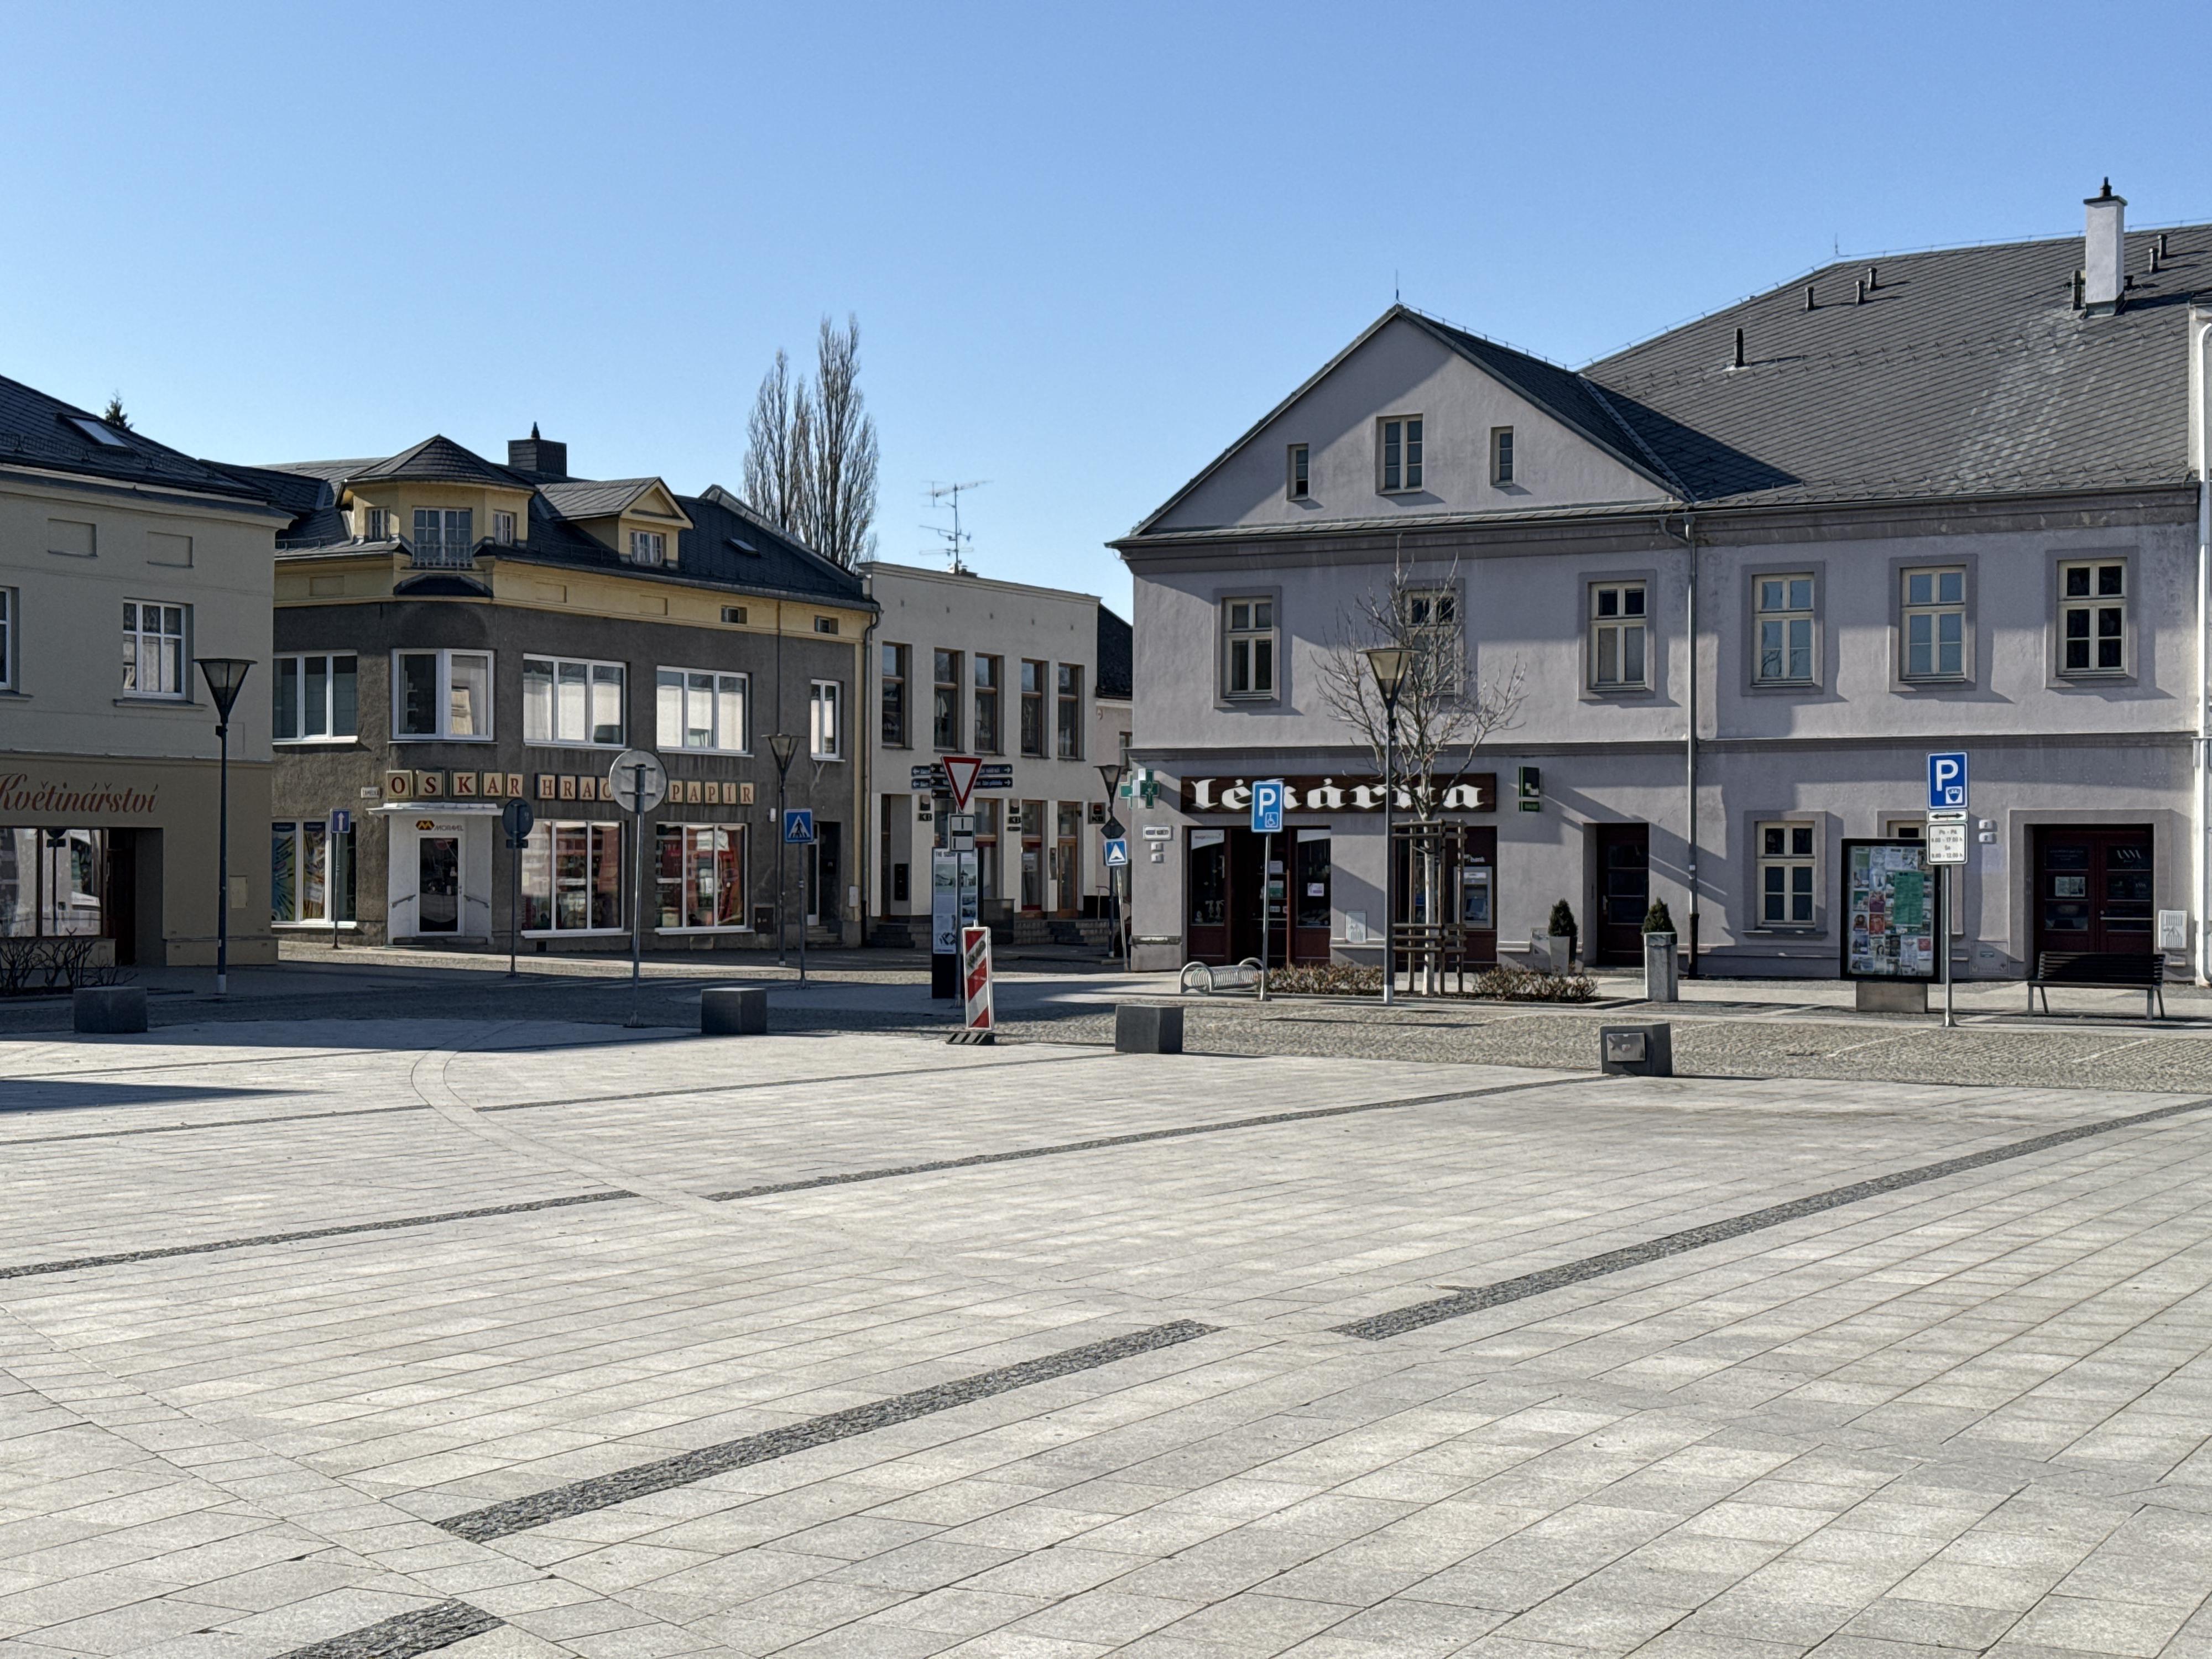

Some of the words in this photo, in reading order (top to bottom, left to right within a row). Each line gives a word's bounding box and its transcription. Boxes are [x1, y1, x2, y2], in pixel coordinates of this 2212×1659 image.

[390, 776, 521, 795] OSKAR
[541, 779, 614, 799] HRAČ
[671, 784, 752, 802] PAPÍR
[1936, 759, 1959, 792] P
[0, 774, 159, 813] Květinářství
[1259, 788, 1276, 817] P
[918, 813, 932, 821] KB
